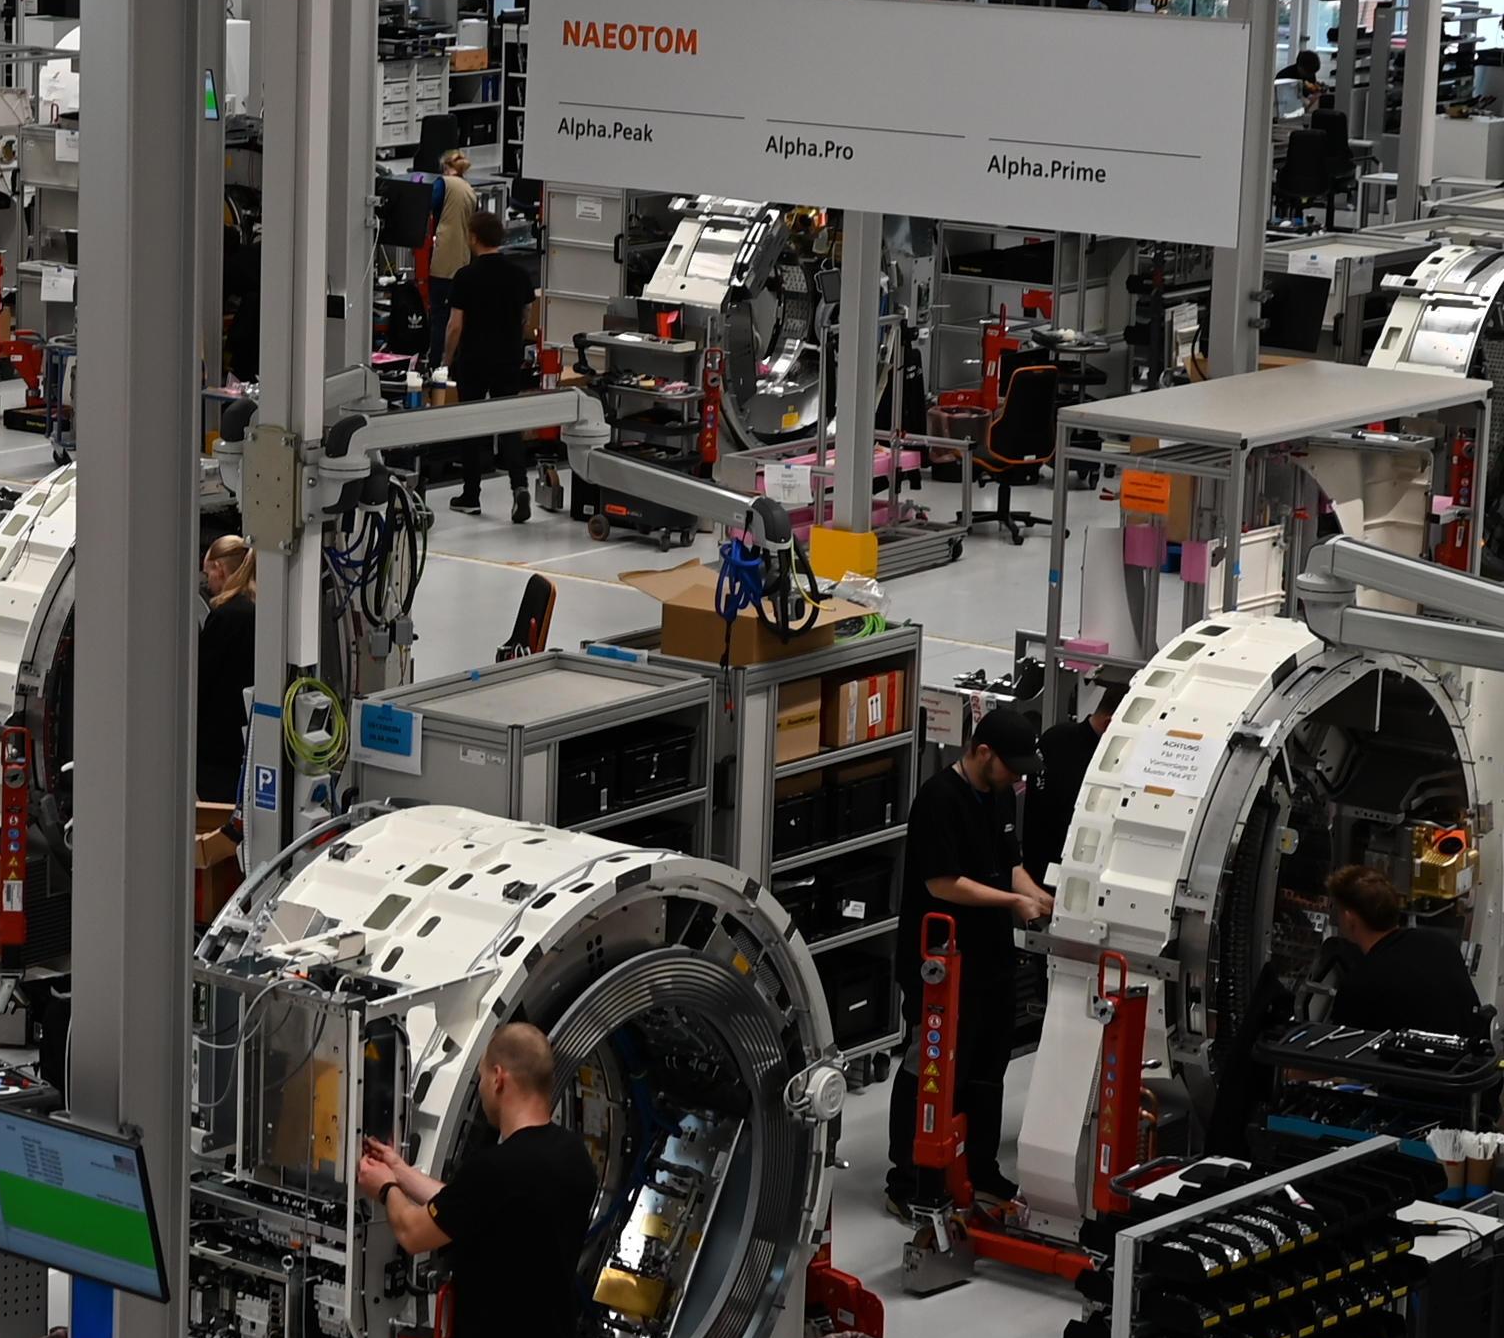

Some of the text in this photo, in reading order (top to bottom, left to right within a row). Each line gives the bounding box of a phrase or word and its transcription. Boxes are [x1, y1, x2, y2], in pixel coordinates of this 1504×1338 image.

[563, 19, 698, 56] NAEOTOM
[557, 117, 653, 143] Alpha.Peak
[765, 135, 854, 161] Alpha.Pro
[987, 154, 1107, 184] Alpha.Prime
[259, 768, 273, 792] P
